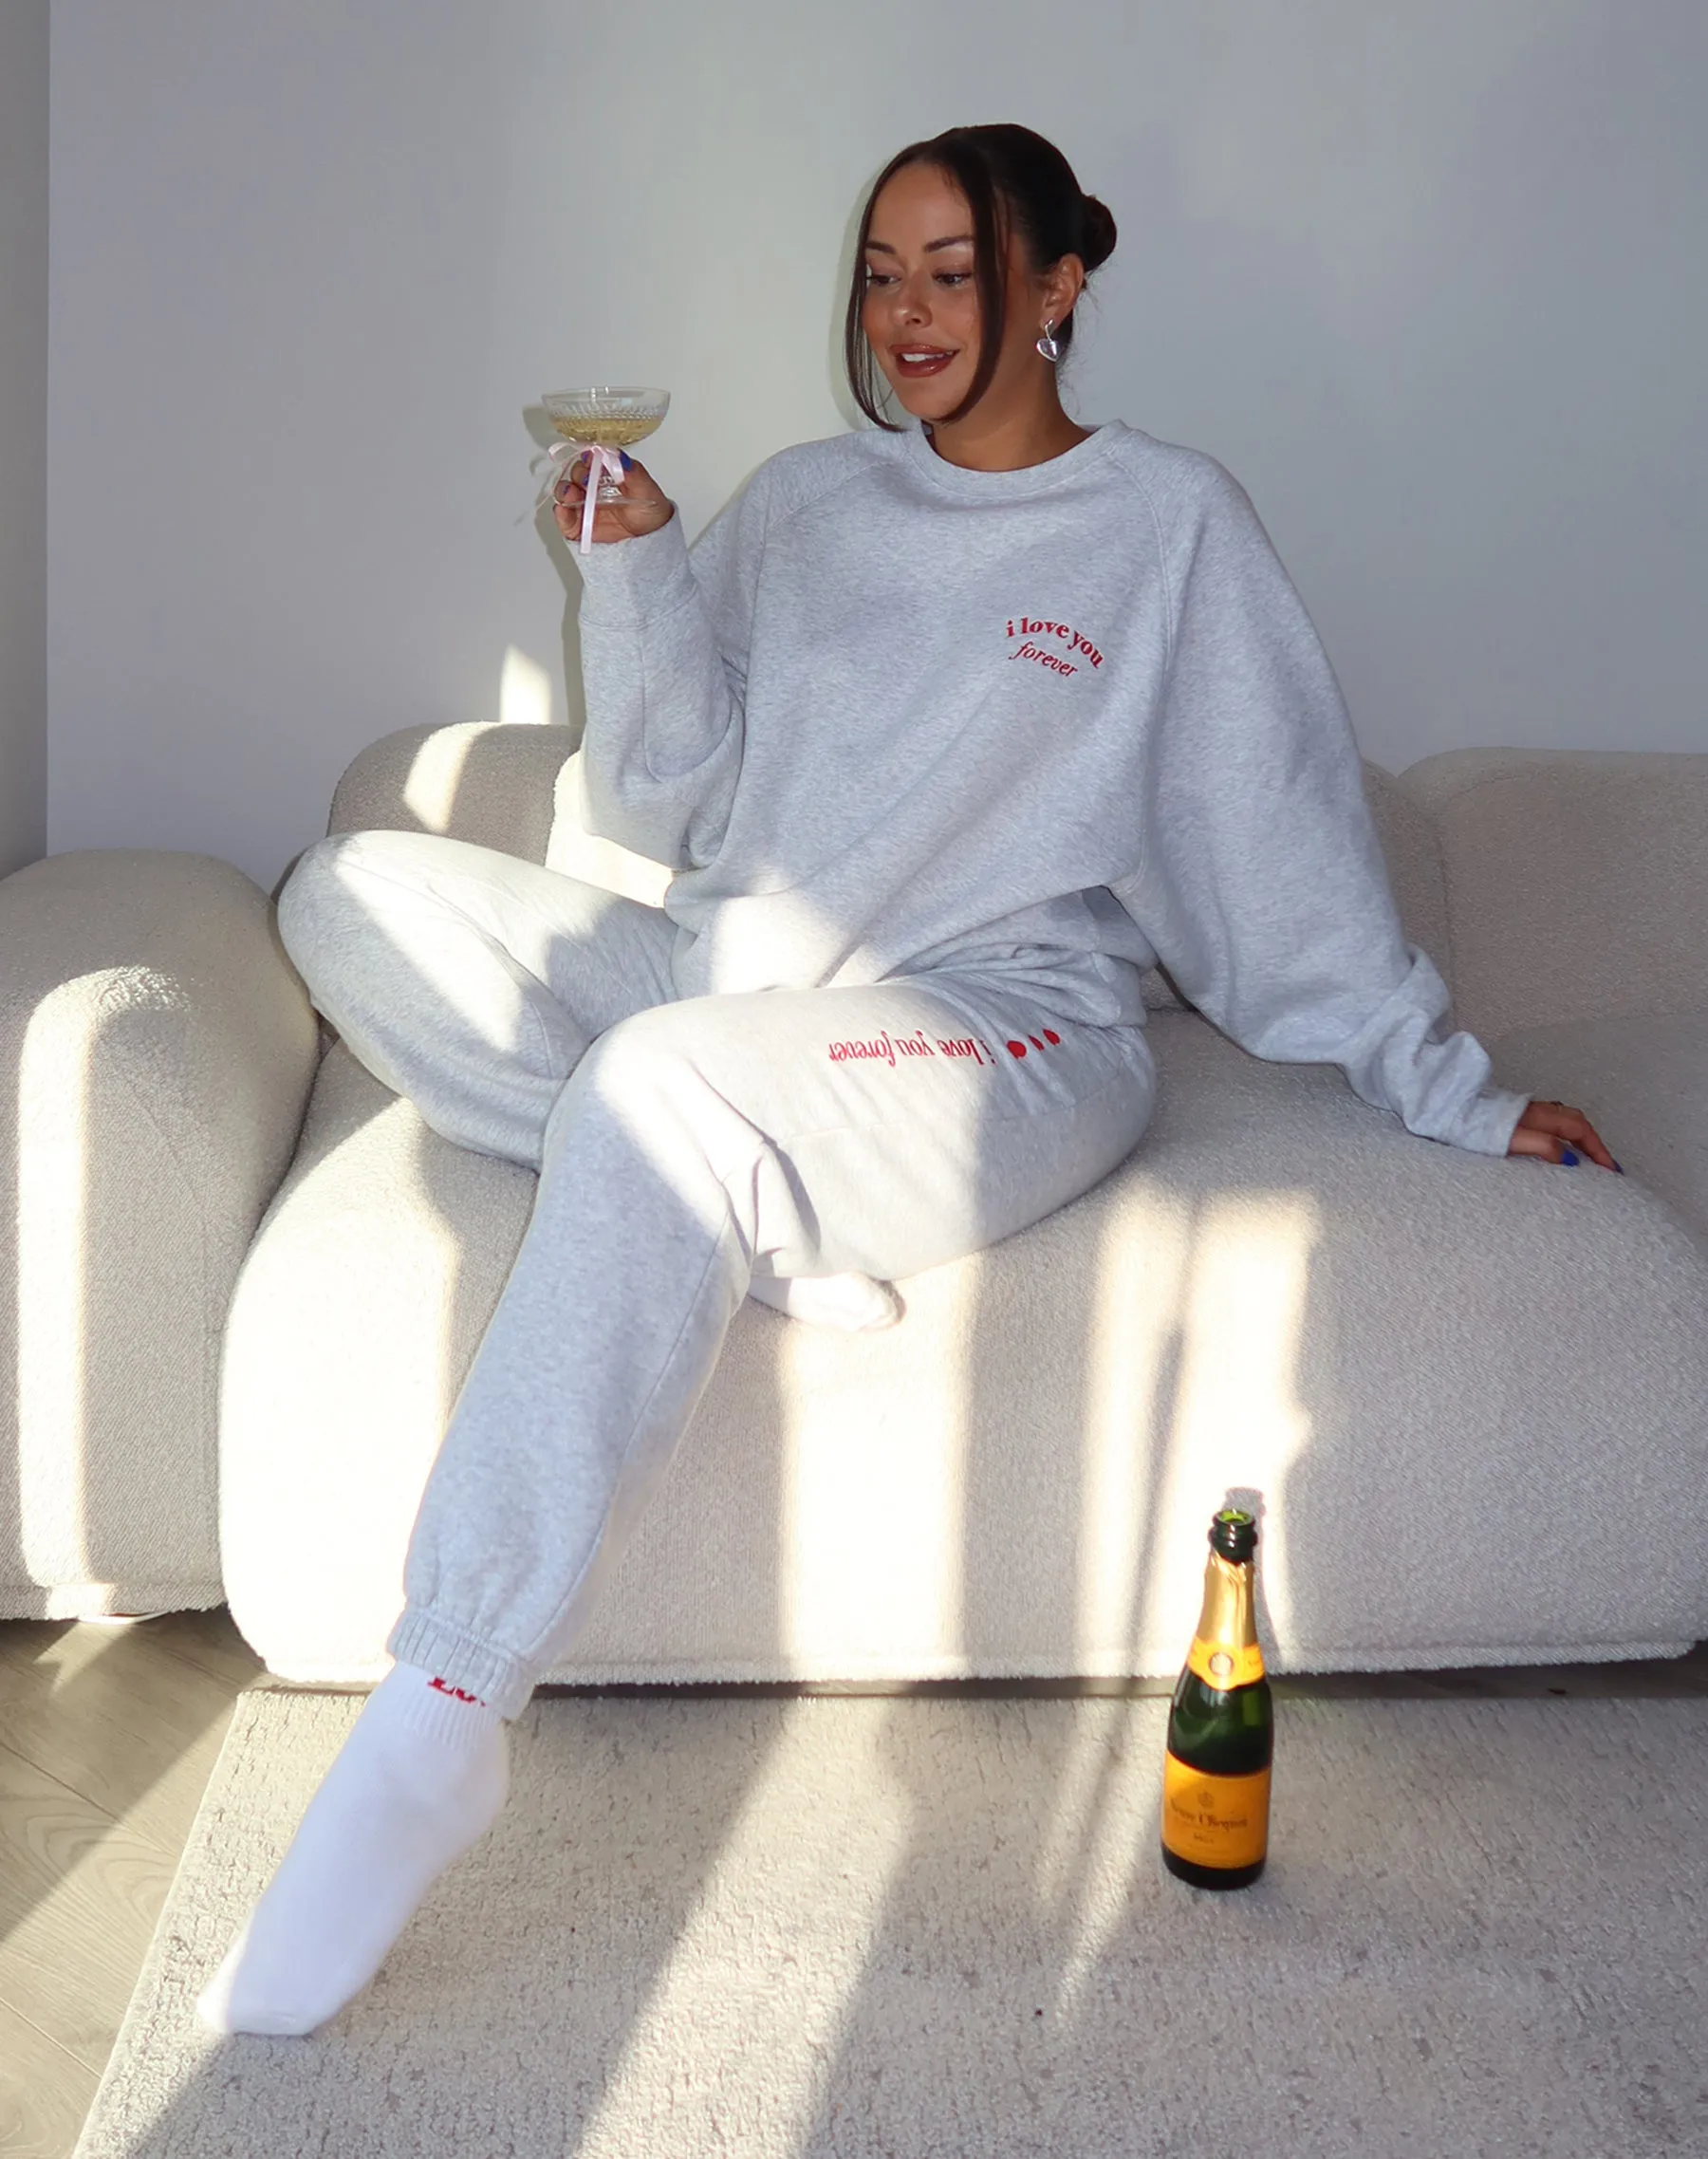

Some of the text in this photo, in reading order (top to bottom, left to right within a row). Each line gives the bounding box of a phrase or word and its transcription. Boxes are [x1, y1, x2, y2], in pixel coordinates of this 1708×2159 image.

[1006, 617, 1104, 669] i love you
[1008, 641, 1079, 677] forever
[828, 1030, 996, 1068] i love you forever
